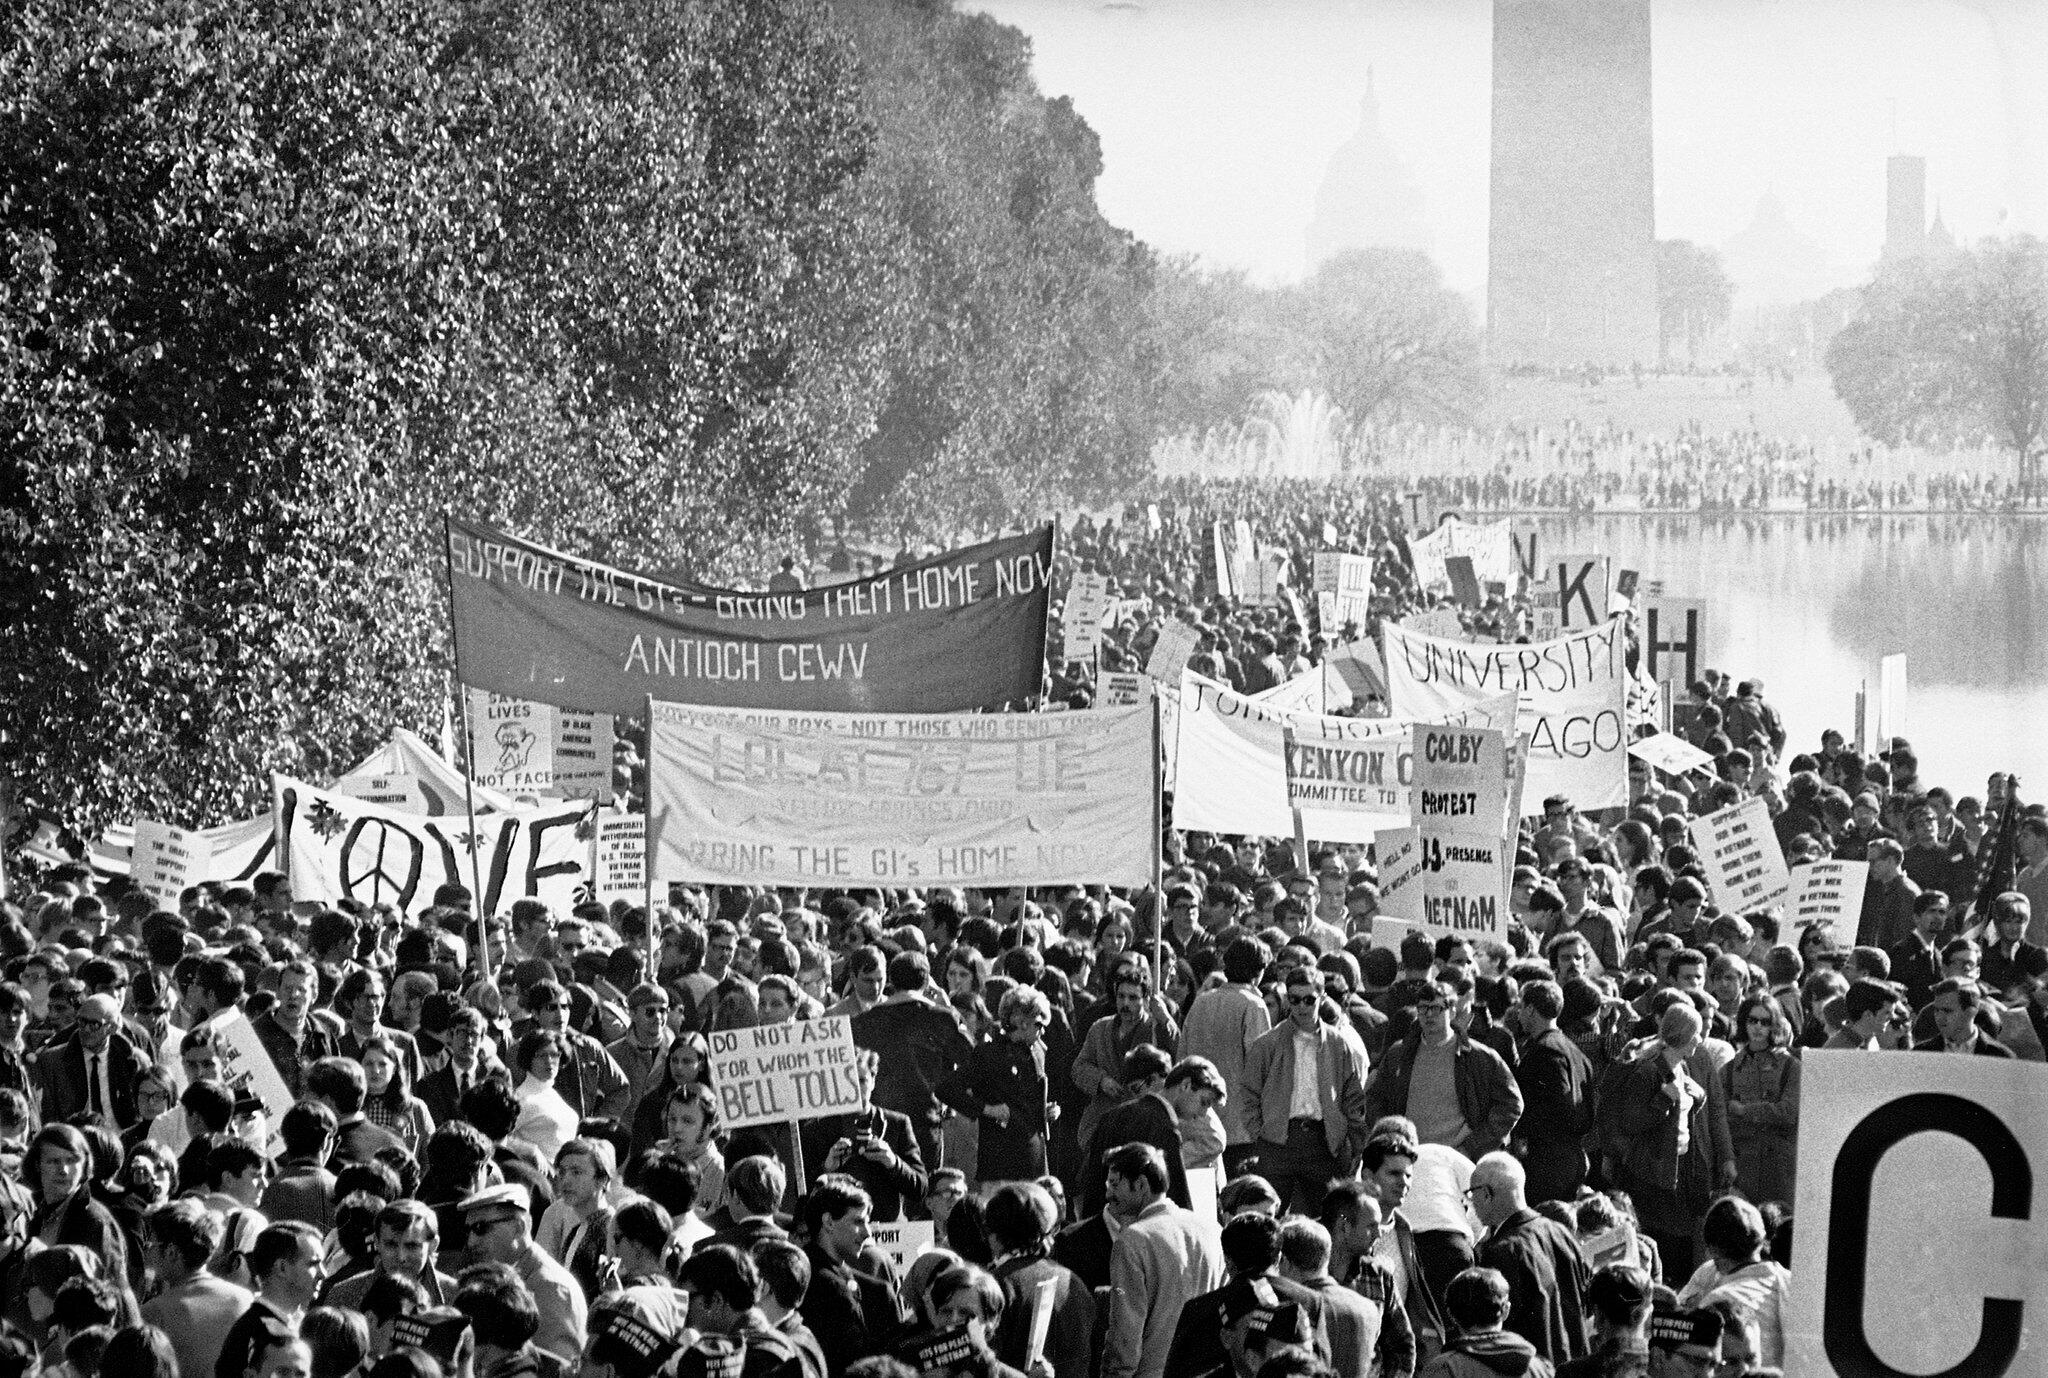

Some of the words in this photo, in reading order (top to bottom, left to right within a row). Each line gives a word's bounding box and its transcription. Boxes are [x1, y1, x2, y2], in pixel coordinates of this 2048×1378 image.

[450, 533, 566, 595] SUPPORT
[574, 565, 626, 607] THE
[716, 595, 806, 621] BRING
[823, 577, 892, 618] THEM
[903, 562, 981, 612] HOME
[1558, 561, 1598, 627] K
[624, 633, 762, 683] ANTIOCH
[777, 642, 869, 682] CEWV
[1402, 621, 1618, 693] UNIVERSITY
[1647, 608, 1698, 690] H
[488, 705, 531, 720] LIVES
[562, 719, 571, 729] OF
[573, 720, 592, 731] BLACK
[744, 714, 782, 732] OUR
[788, 716, 833, 734] BOYS
[850, 719, 888, 738] NOT
[895, 719, 952, 737] THOSE
[957, 718, 999, 738] WHO
[1005, 717, 1050, 738] SEND
[562, 733, 592, 745] AMERICAN
[1425, 732, 1484, 765] COLBY
[556, 747, 597, 760] COMMUNITIES
[1284, 741, 1385, 787] KENYON
[476, 772, 505, 788] NOT
[515, 771, 552, 786] FACE
[1288, 782, 1367, 802] OMMITTEE
[1421, 789, 1477, 816] PROTEST
[600, 831, 645, 841] WITHDRAWA
[608, 862, 641, 871] VIETNAM
[619, 851, 643, 860] TROOP
[789, 844, 852, 877] THE
[871, 848, 920, 878] GI's
[938, 845, 1017, 876] HOME
[1445, 846, 1493, 864] PRESENCE
[628, 871, 640, 880] THE
[1811, 864, 1843, 875] SUPPORT
[713, 1031, 738, 1054] DO
[753, 1024, 793, 1048] NOT
[801, 1018, 842, 1043] ASK
[716, 1059, 750, 1080] FOR
[757, 1052, 810, 1074] WHOM
[814, 1046, 850, 1066] THE
[719, 1077, 785, 1121] BELL
[789, 1064, 860, 1109] TOLLS
[872, 1229, 900, 1243] PORT
[1824, 1092, 2033, 1378] C
